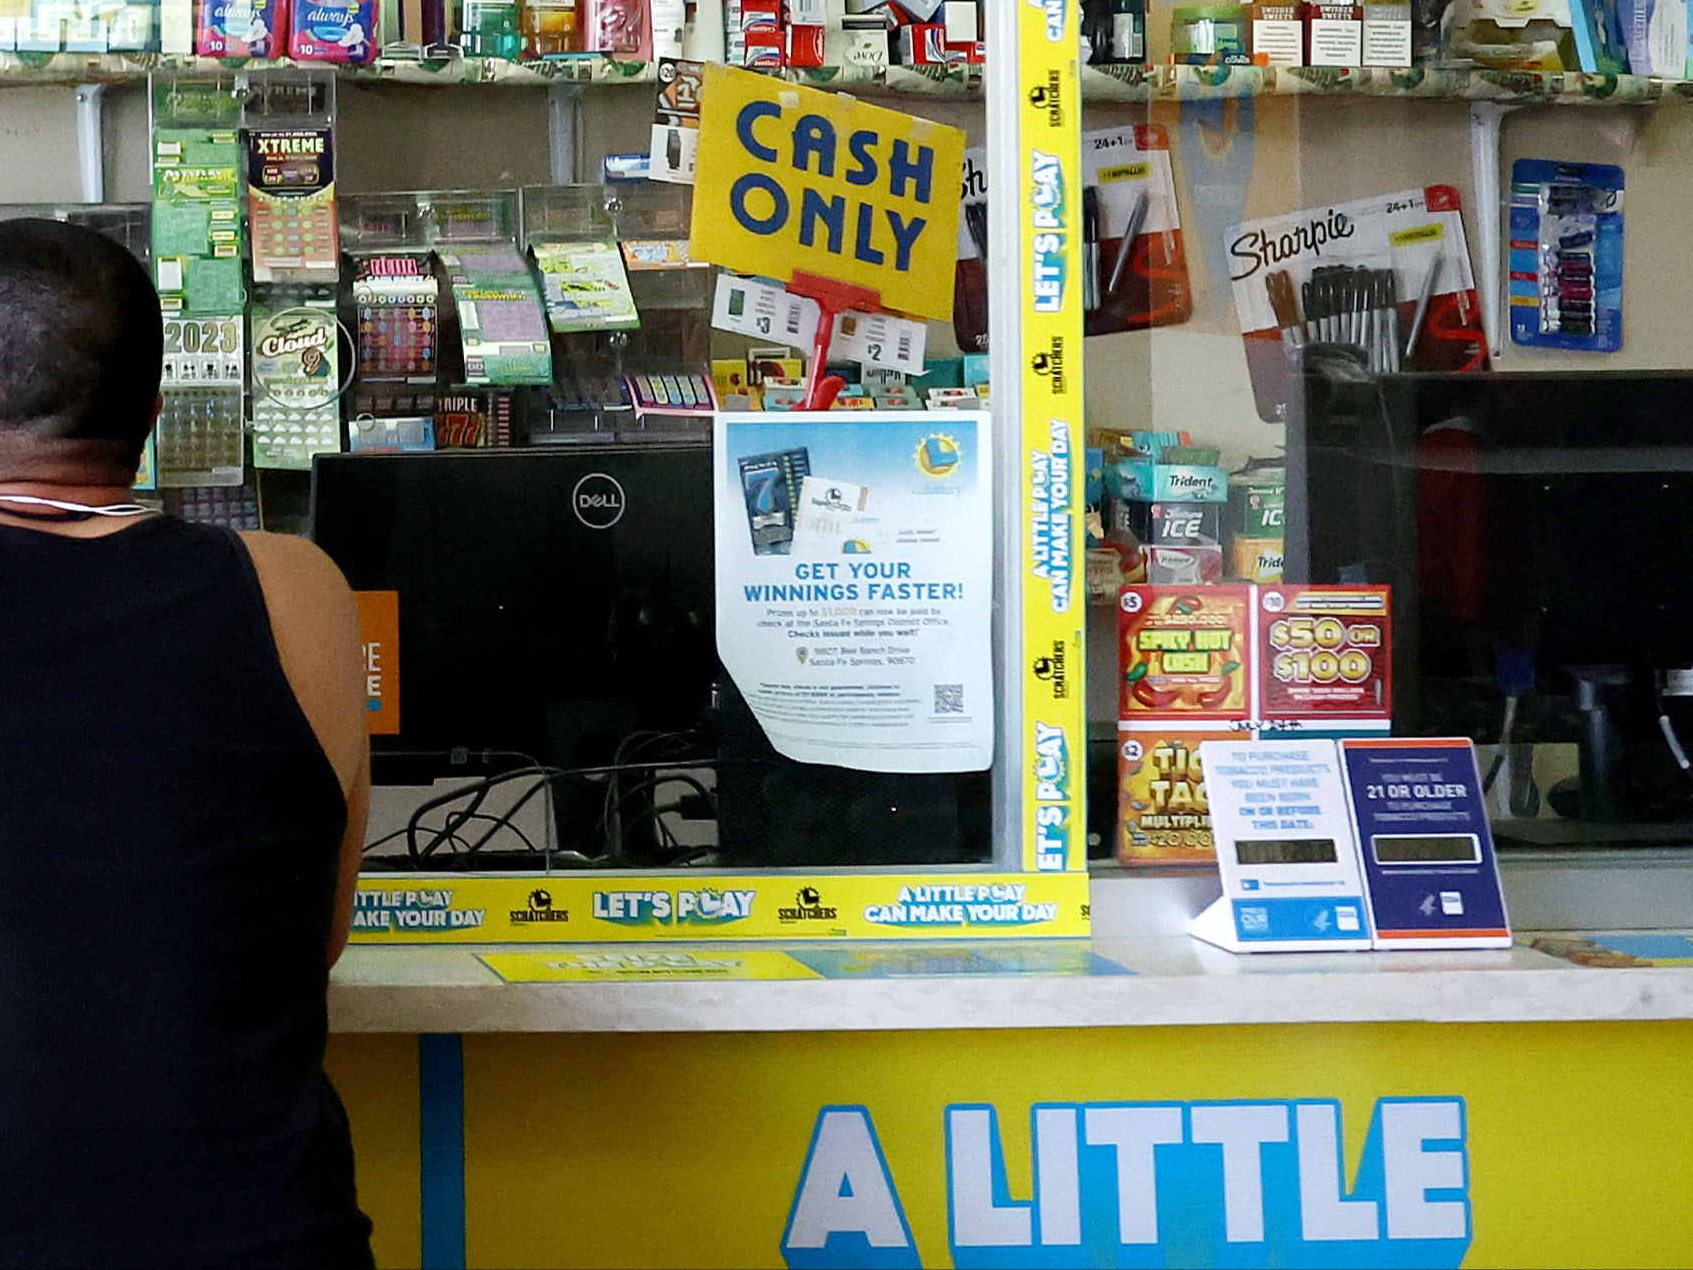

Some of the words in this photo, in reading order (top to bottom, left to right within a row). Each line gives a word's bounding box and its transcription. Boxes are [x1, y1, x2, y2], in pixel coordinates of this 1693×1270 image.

[214, 3, 261, 21] always
[307, 10, 355, 27] always
[257, 137, 324, 154] XTREME
[736, 100, 934, 204] CASH
[730, 172, 927, 272] ONLY
[1230, 207, 1355, 281] Sharpie
[1033, 233, 1061, 313] LET'S
[756, 316, 771, 335] $3
[164, 321, 237, 354] 2023
[261, 326, 328, 358] Cloud
[867, 342, 881, 362] $2
[301, 350, 323, 376] 9
[1168, 473, 1214, 490] Trident
[579, 493, 620, 508] DELL
[1161, 520, 1203, 538] ICE
[795, 562, 840, 581] GET
[848, 561, 912, 580] YOUR
[743, 583, 860, 602] WINNINGS
[867, 582, 964, 601] FASTER!
[1271, 618, 1345, 651] $50
[1274, 649, 1372, 684] $100
[1366, 785, 1385, 800] 21
[1387, 785, 1411, 799] OR
[1414, 784, 1467, 800] OLDER
[783, 1105, 909, 1250] A
[947, 1098, 1470, 1248] LITTLE
